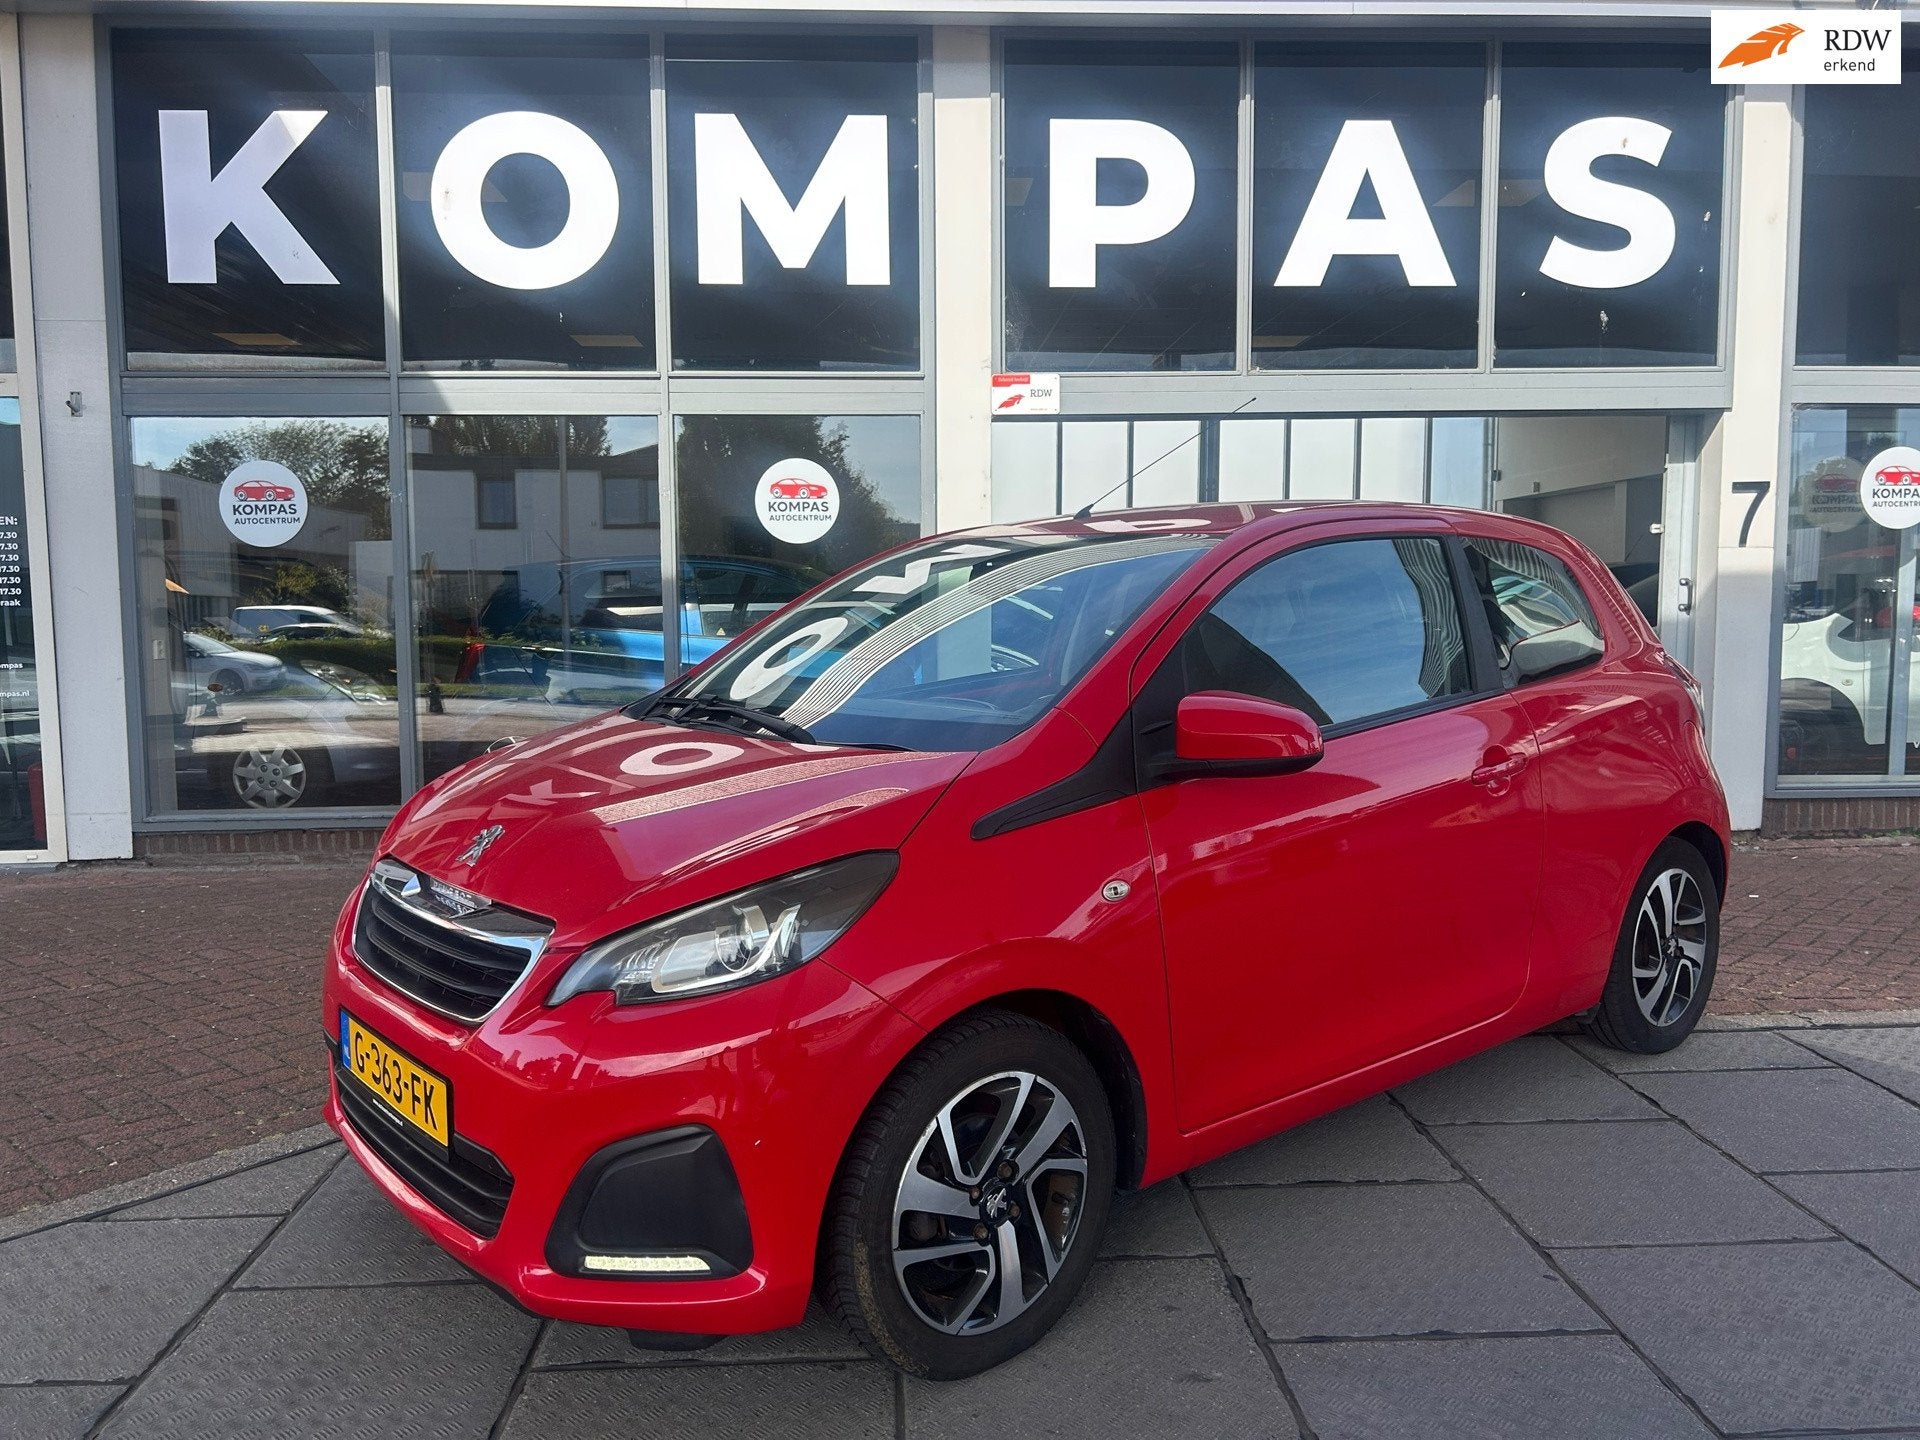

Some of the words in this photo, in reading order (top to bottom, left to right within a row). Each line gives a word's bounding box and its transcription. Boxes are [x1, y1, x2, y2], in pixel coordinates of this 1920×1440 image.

[1030, 389, 1052, 397] RDW
[1872, 488, 1920, 498] KOMPA
[232, 504, 297, 515] KOMPAS
[768, 501, 829, 512] KOMPAS
[769, 514, 832, 522] AUTOCENTRUM
[1732, 481, 1770, 547] 7
[234, 517, 301, 525] AUTOCENTRUM
[355, 1031, 437, 1131] G-363-FK
